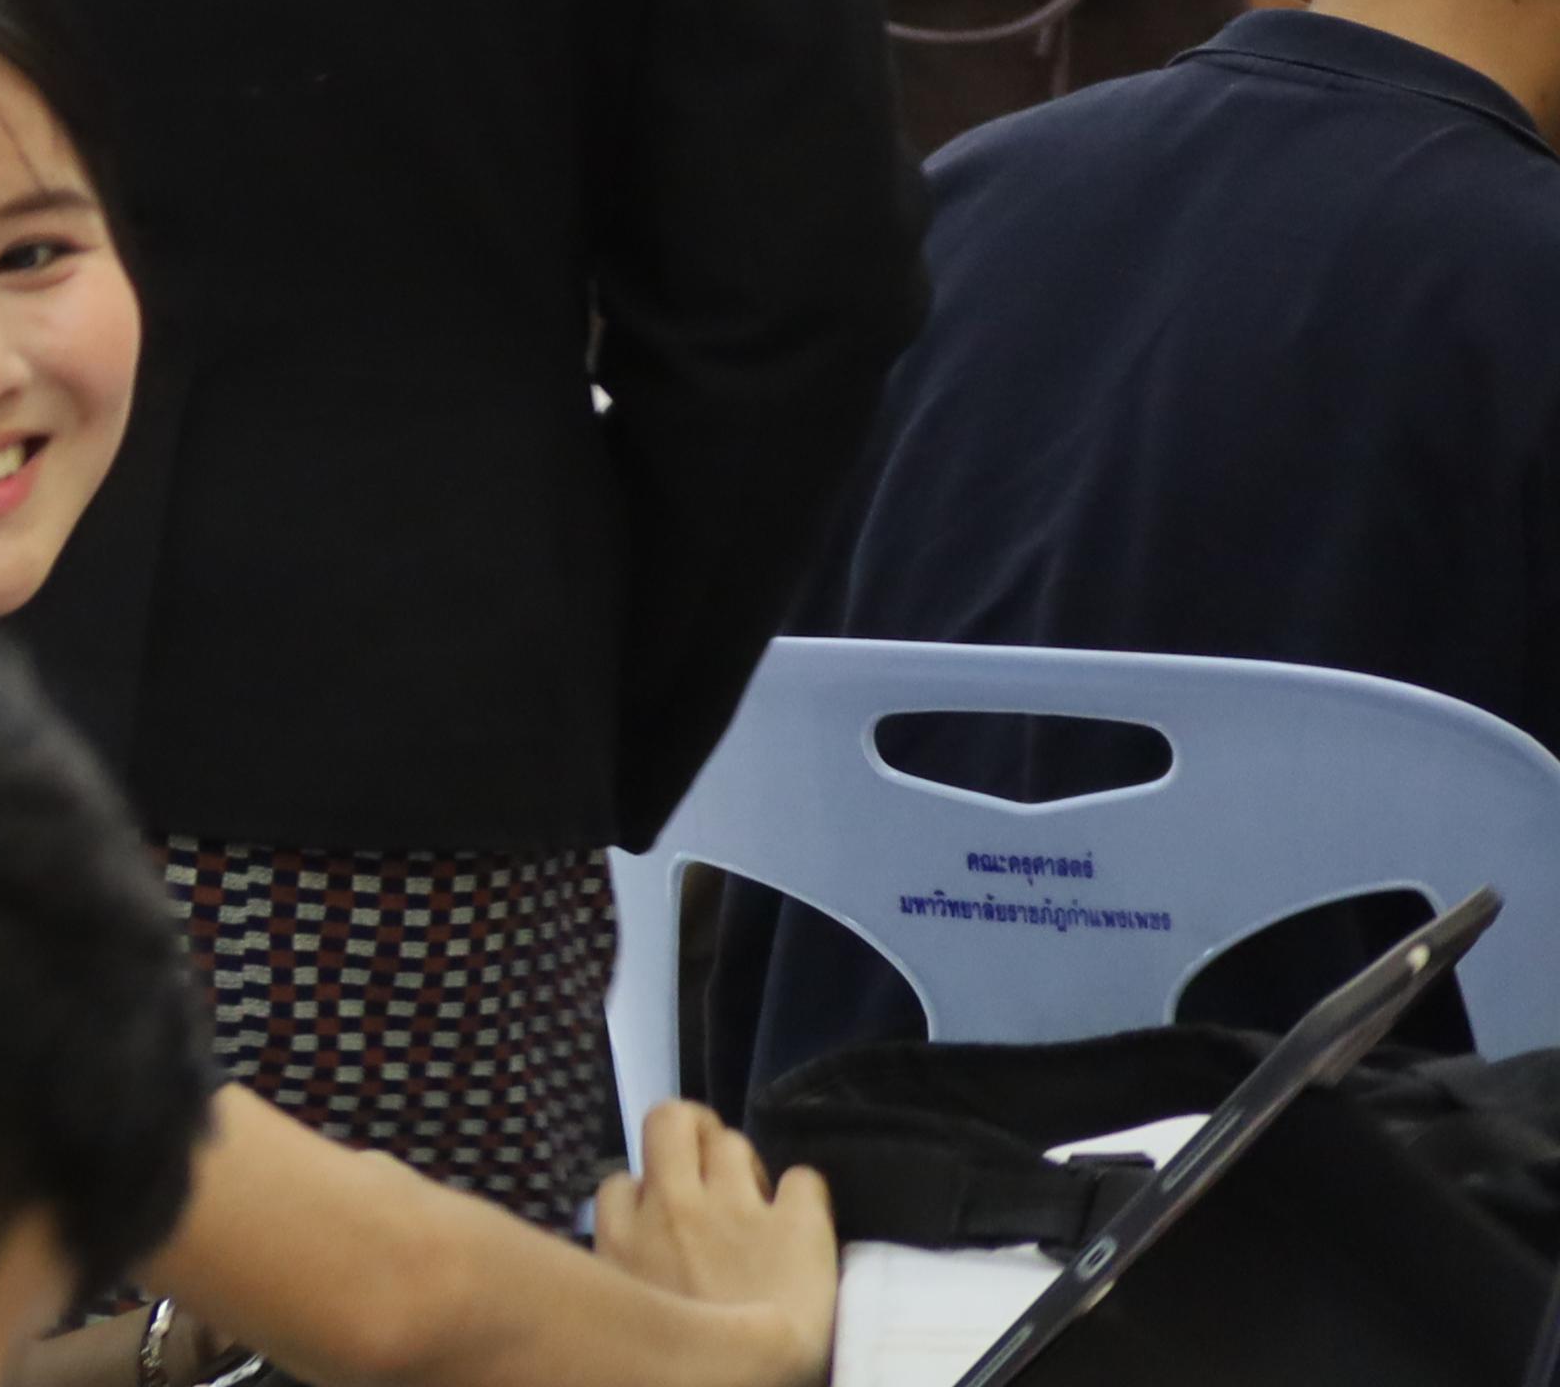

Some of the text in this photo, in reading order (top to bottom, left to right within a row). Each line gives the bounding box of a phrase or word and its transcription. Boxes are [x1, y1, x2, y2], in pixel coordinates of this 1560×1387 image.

[966, 850, 1094, 887] คณะครุศาสตร์
